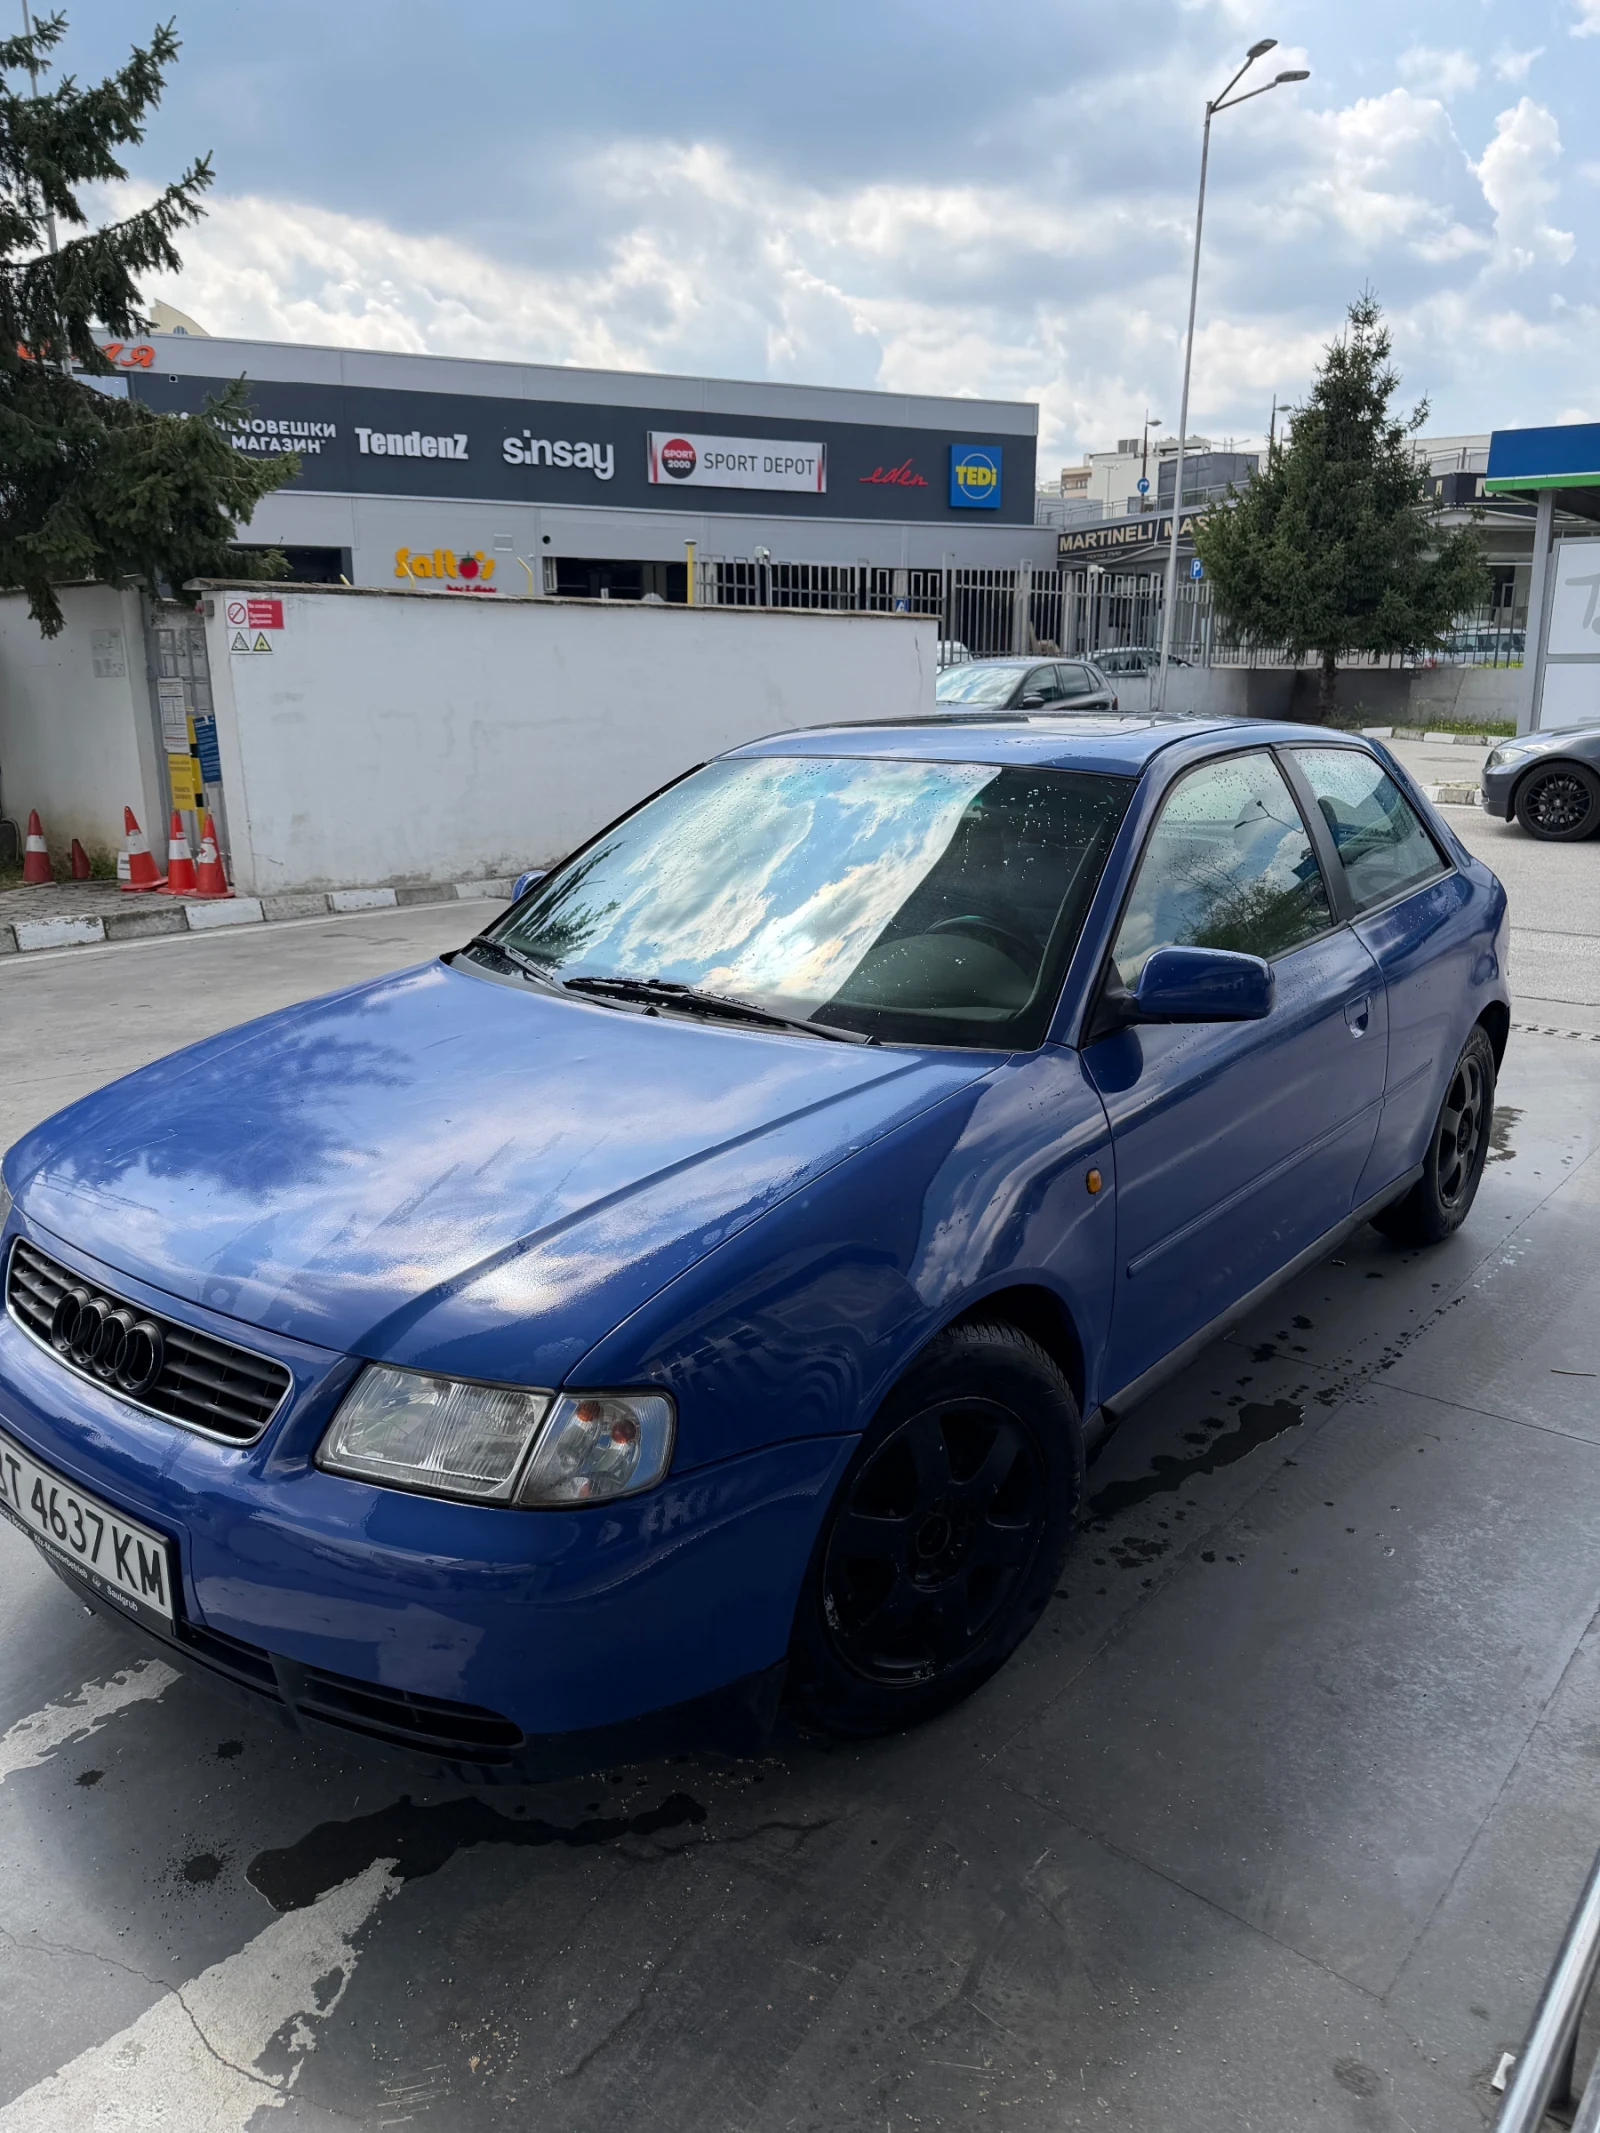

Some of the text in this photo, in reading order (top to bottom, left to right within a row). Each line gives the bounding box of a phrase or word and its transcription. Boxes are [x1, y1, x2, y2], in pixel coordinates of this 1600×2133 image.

[355, 427, 469, 460] TendenZ
[502, 429, 615, 480] sinsay
[663, 449, 694, 459] SPORT
[667, 459, 691, 468] 2000
[704, 452, 815, 475] SPORT DEPOT
[859, 458, 929, 487] eden
[955, 465, 997, 487] TEDi
[1059, 523, 1153, 552] MARTINELI
[1193, 561, 1201, 576] P
[31, 1477, 104, 1564] 4637
[112, 1525, 165, 1606] KM
